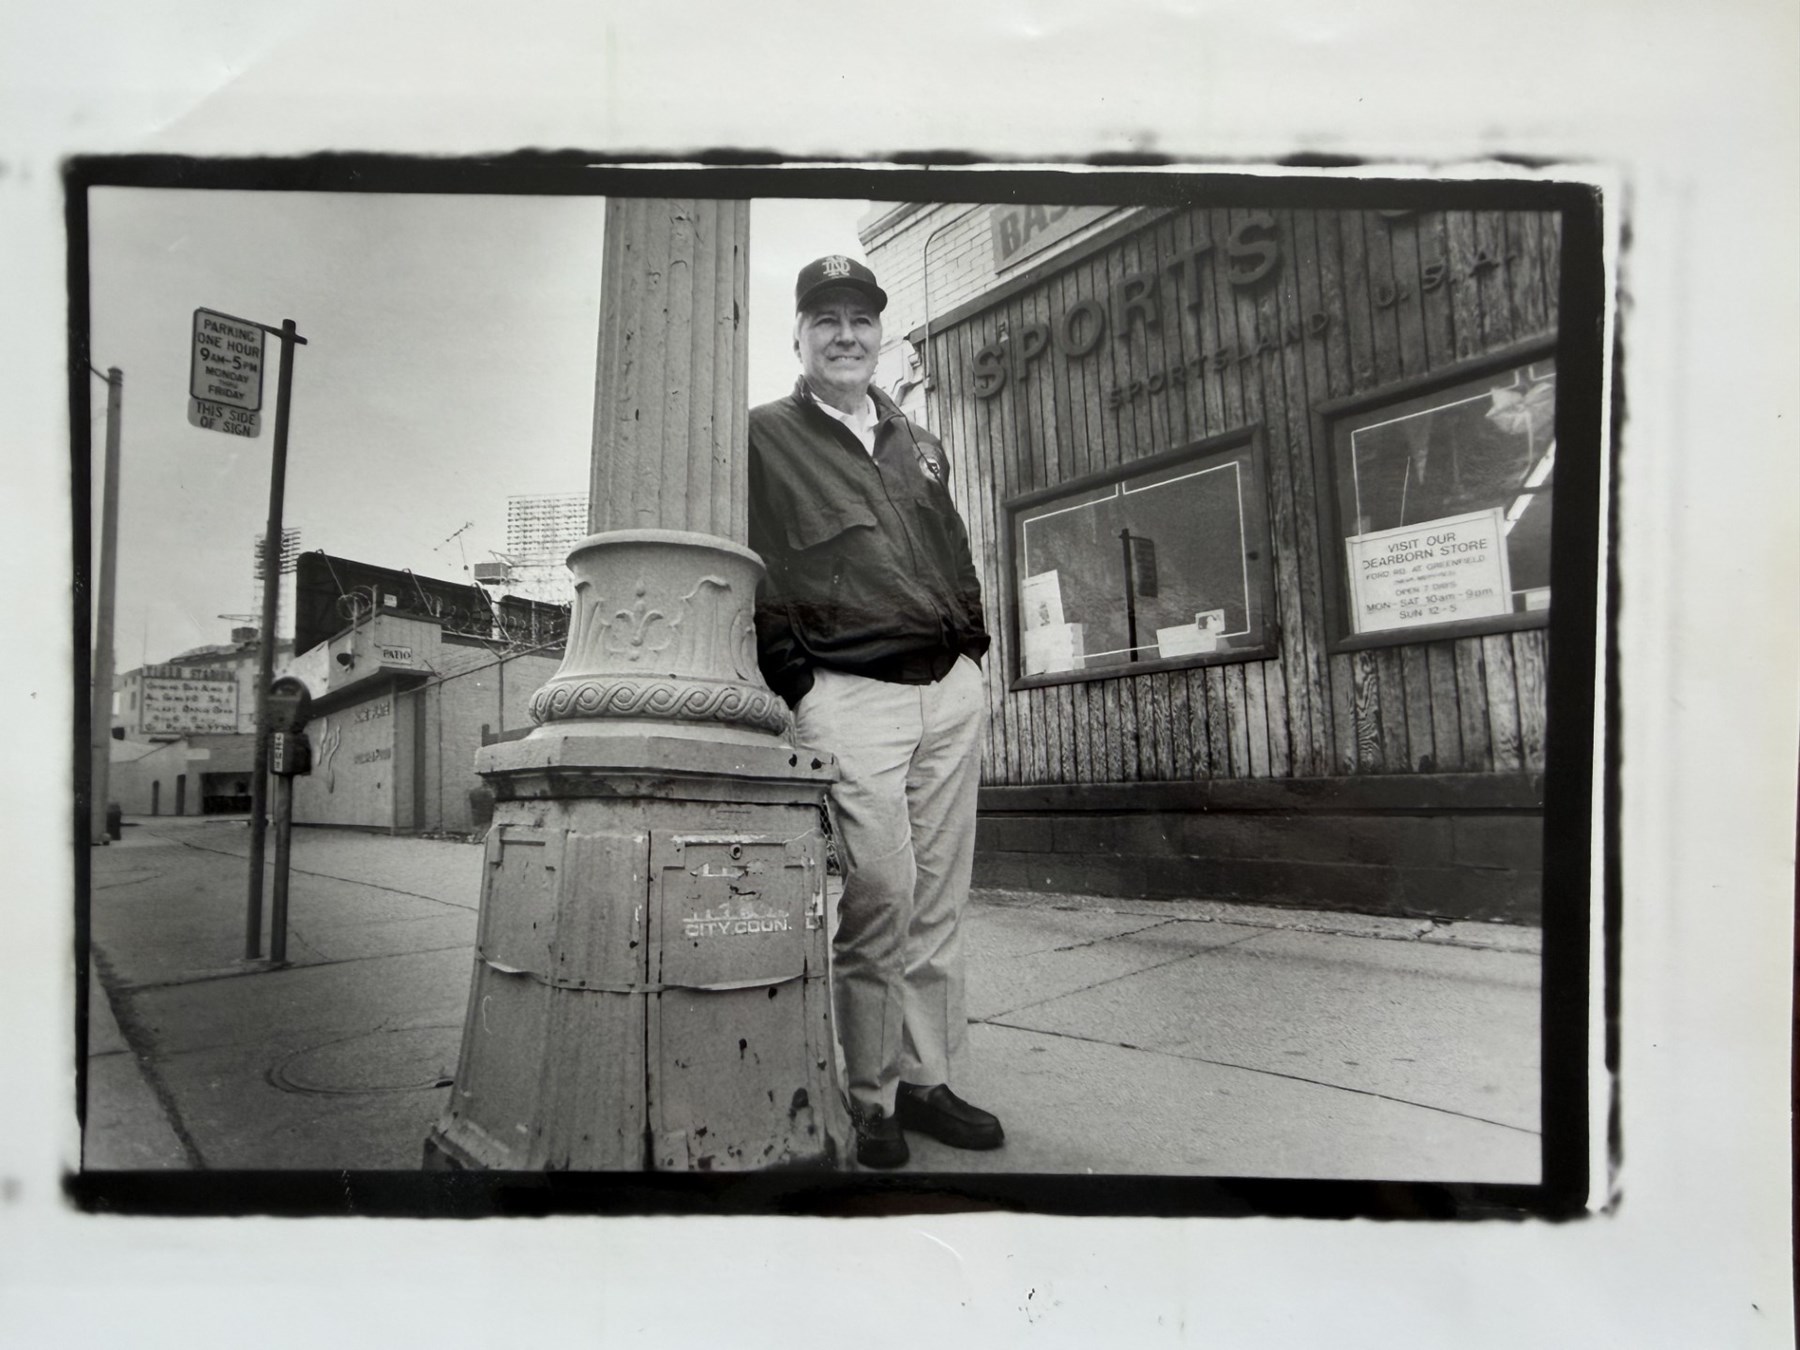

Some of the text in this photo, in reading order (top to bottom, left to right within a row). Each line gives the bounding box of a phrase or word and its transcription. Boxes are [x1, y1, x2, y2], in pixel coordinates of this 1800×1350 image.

[973, 212, 1285, 399] SPORTS
[203, 319, 256, 343] PARKING
[197, 332, 260, 358] ONE HOUR
[205, 366, 249, 384] MONDAY
[208, 384, 245, 400] FRIDAY
[197, 402, 256, 425] THIS SIDE
[200, 416, 251, 437] OF SIGN
[1387, 532, 1456, 553] VISIT OUR
[1362, 538, 1489, 570] DEARBORN STORE
[383, 649, 412, 659] PATIO
[685, 921, 731, 937] CITY
